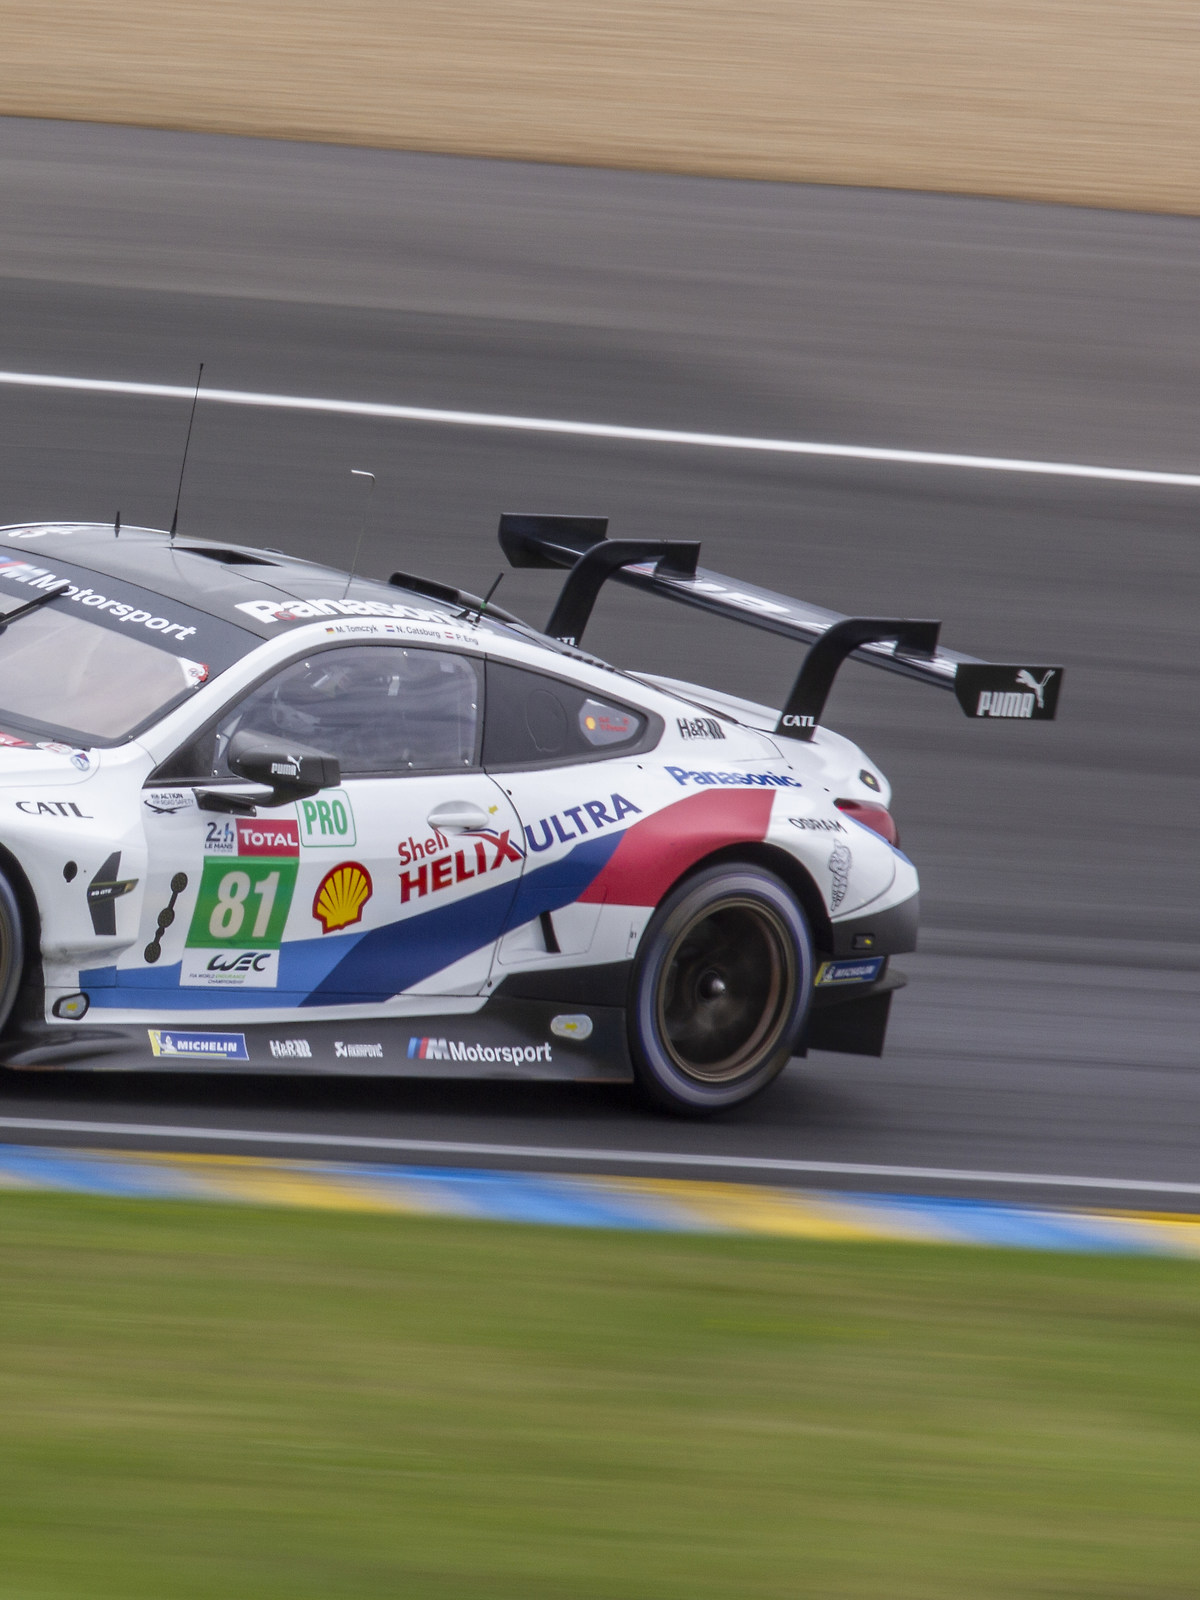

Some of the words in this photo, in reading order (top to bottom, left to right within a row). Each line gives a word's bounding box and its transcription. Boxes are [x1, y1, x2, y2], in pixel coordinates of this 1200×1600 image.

[28, 574, 197, 641] Motorsport
[335, 626, 345, 634] M.
[346, 625, 378, 634] Tomczyk
[396, 626, 406, 634] N.
[406, 627, 441, 639] Catsburg
[976, 691, 1035, 718] PUMA
[676, 717, 708, 740] H&R
[782, 715, 815, 728] CATL
[271, 763, 297, 776] PUMA
[664, 766, 802, 787] Panasonic
[15, 801, 94, 819] CATL
[302, 800, 348, 835] PRO
[788, 818, 848, 834] OSRAM
[240, 829, 298, 847] TOTAL
[398, 828, 449, 866] Shell
[399, 829, 523, 904] HELIX
[524, 793, 643, 852] ULTRA
[209, 871, 280, 938] 81
[207, 952, 271, 972] WEC
[177, 1040, 238, 1052] MICHELIN
[449, 1041, 552, 1066] Motorsport
